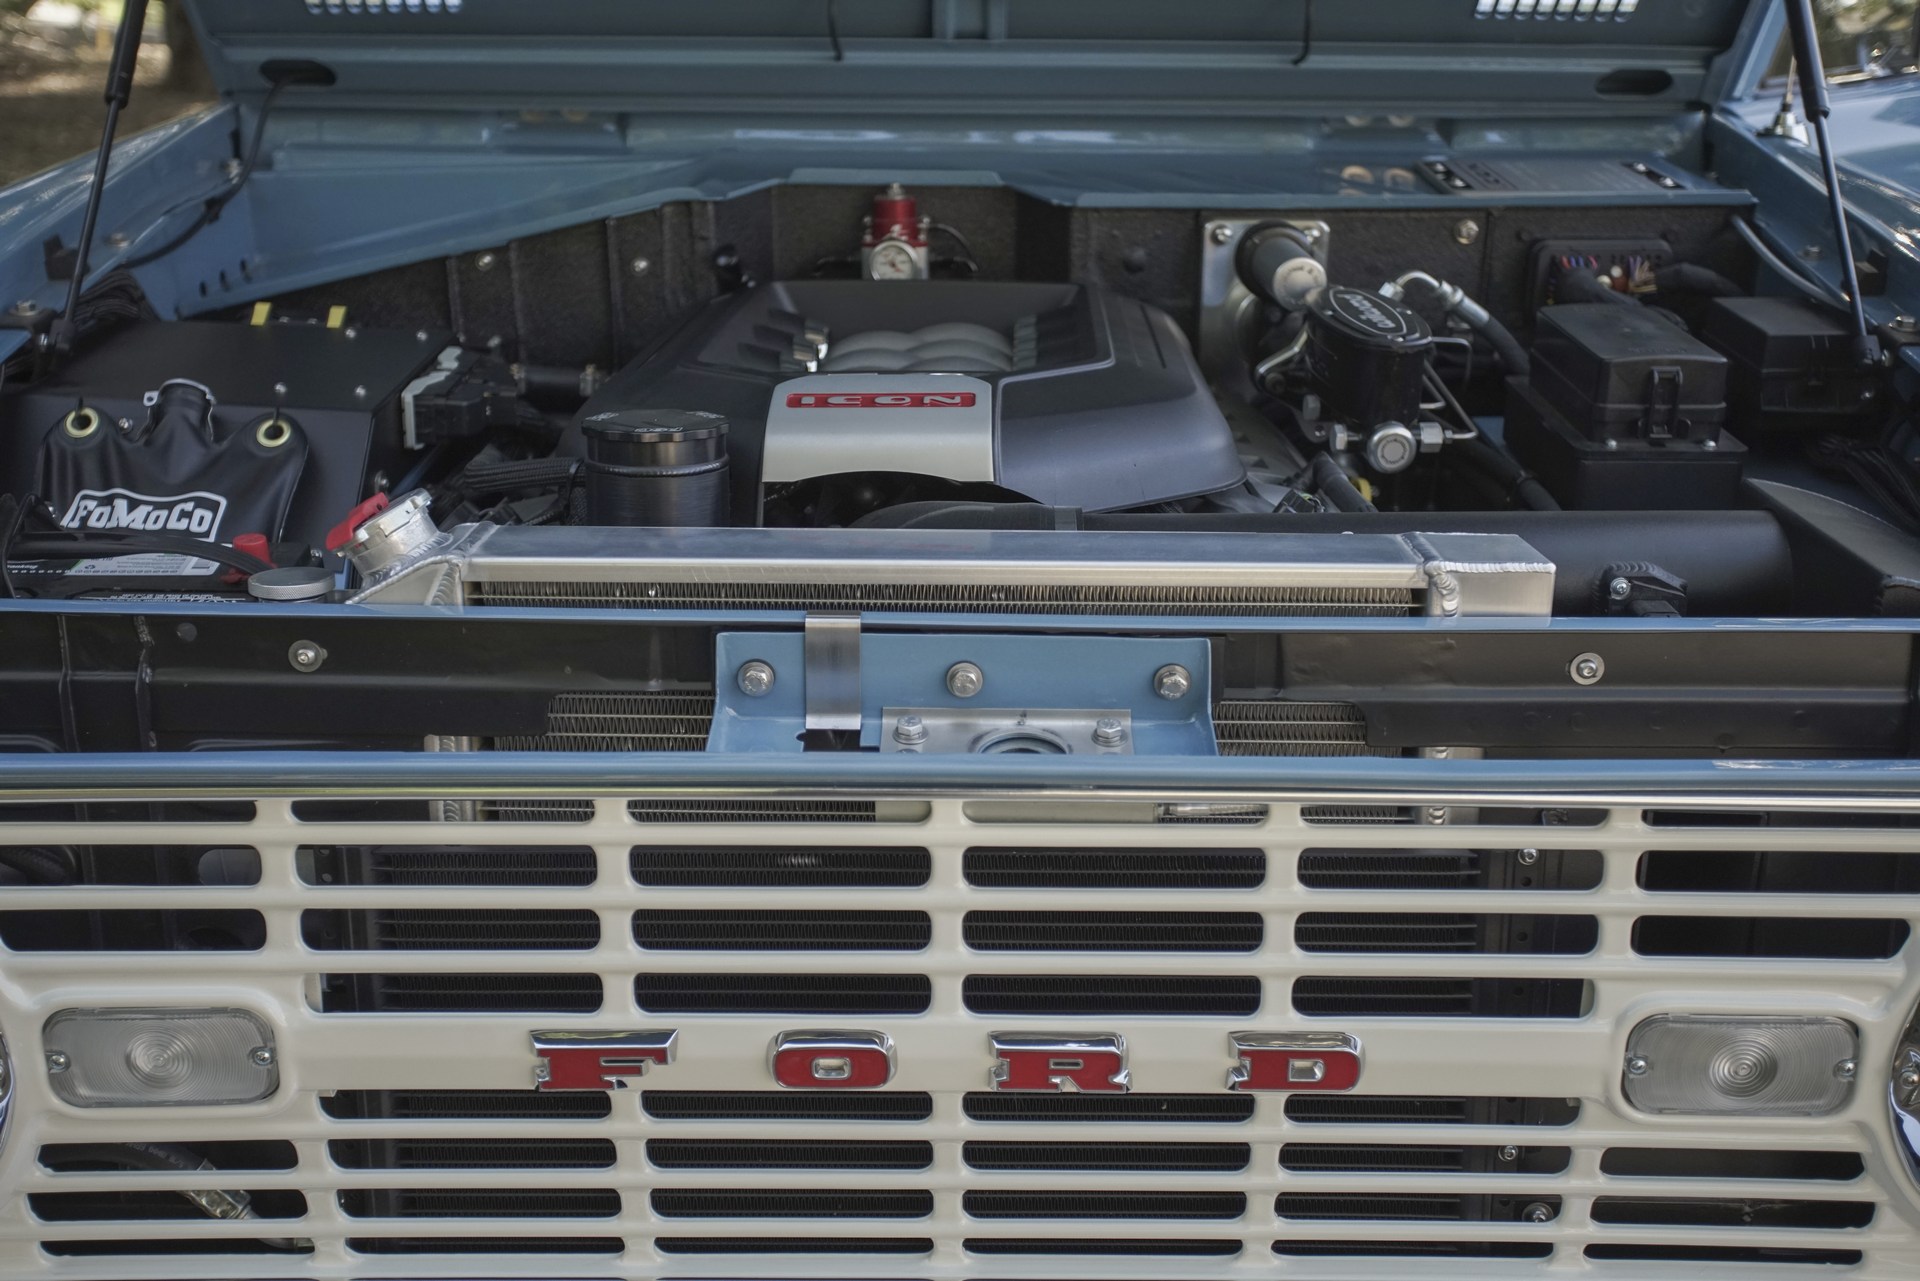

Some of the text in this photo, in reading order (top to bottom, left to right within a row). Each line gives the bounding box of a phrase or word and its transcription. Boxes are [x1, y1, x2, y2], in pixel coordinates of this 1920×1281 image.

[800, 395, 962, 407] ICON
[67, 498, 213, 533] FoMoCo
[530, 1029, 1364, 1093] FORD
